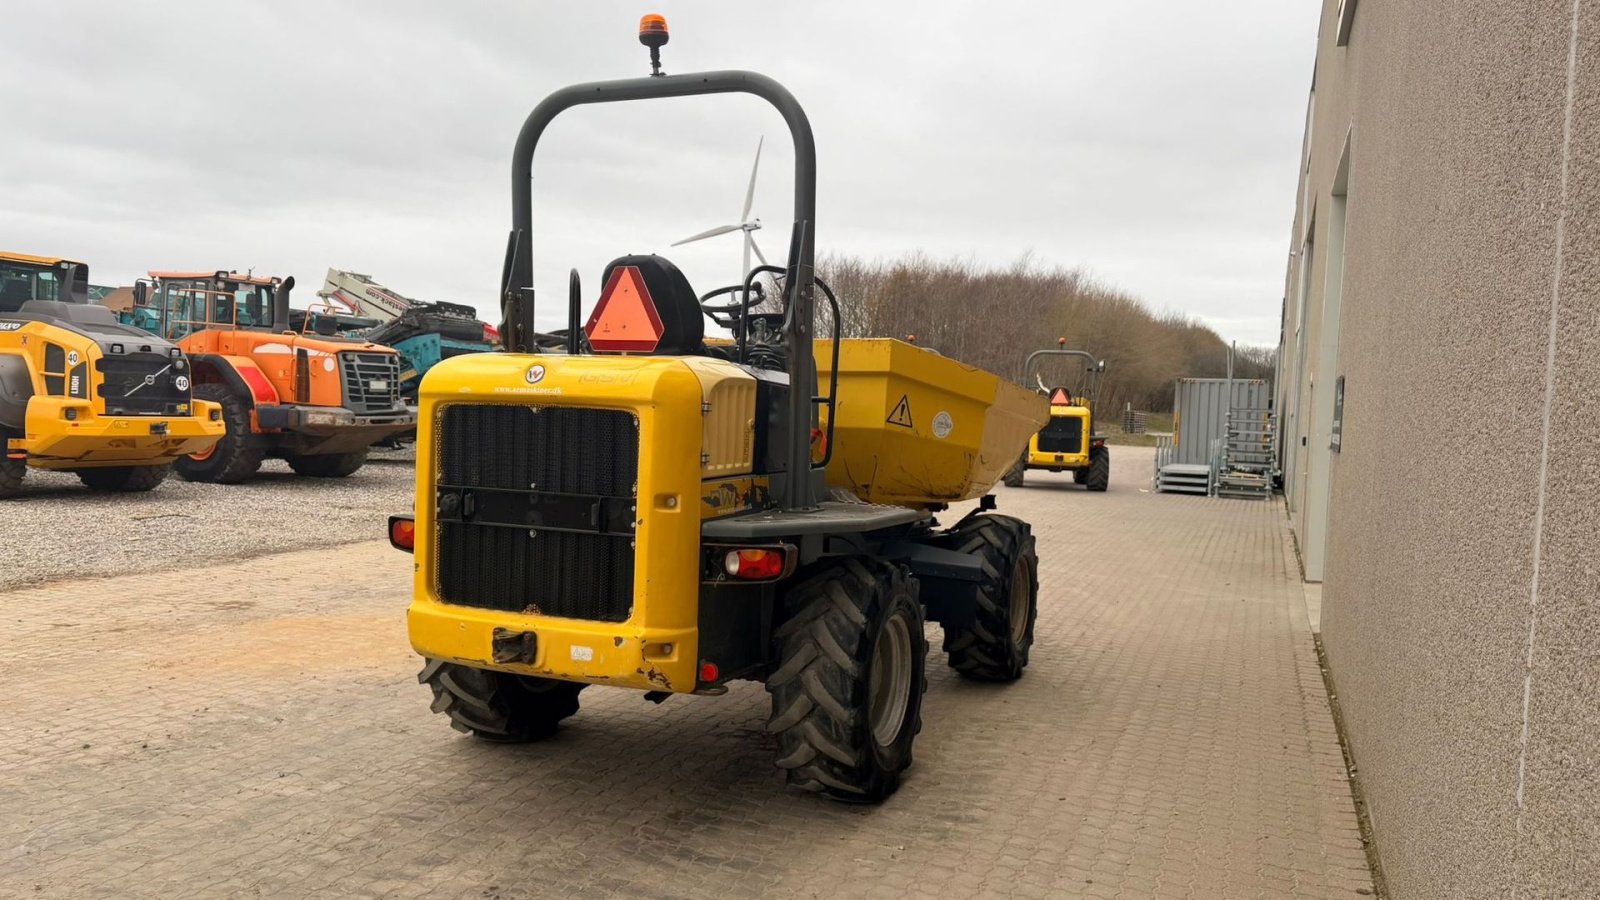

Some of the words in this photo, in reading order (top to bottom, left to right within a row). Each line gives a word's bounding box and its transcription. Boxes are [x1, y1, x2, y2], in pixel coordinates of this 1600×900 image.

[365, 289, 404, 311] estack.com
[68, 353, 78, 363] 40
[177, 379, 188, 389] 40
